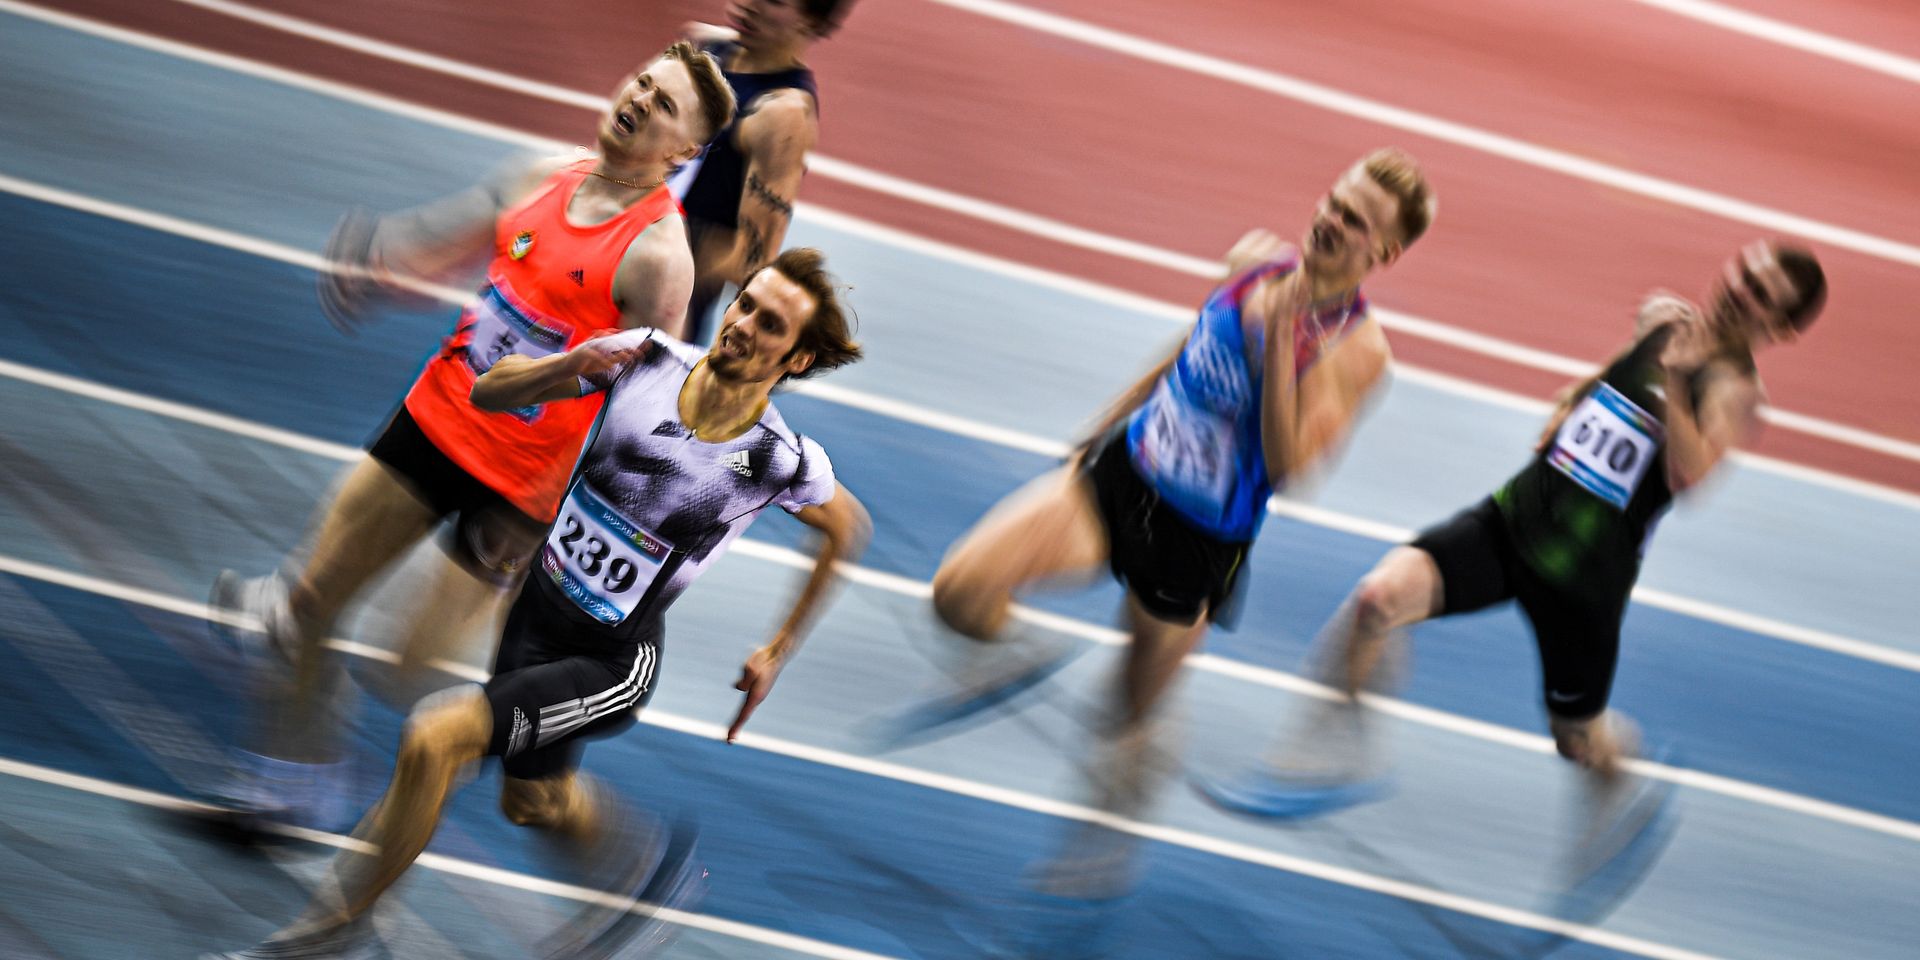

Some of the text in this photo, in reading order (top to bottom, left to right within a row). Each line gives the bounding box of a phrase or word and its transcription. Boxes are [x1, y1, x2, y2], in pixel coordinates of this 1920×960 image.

[717, 458, 753, 477] adidas
[1571, 415, 1639, 474] 610
[559, 515, 639, 594] 239
